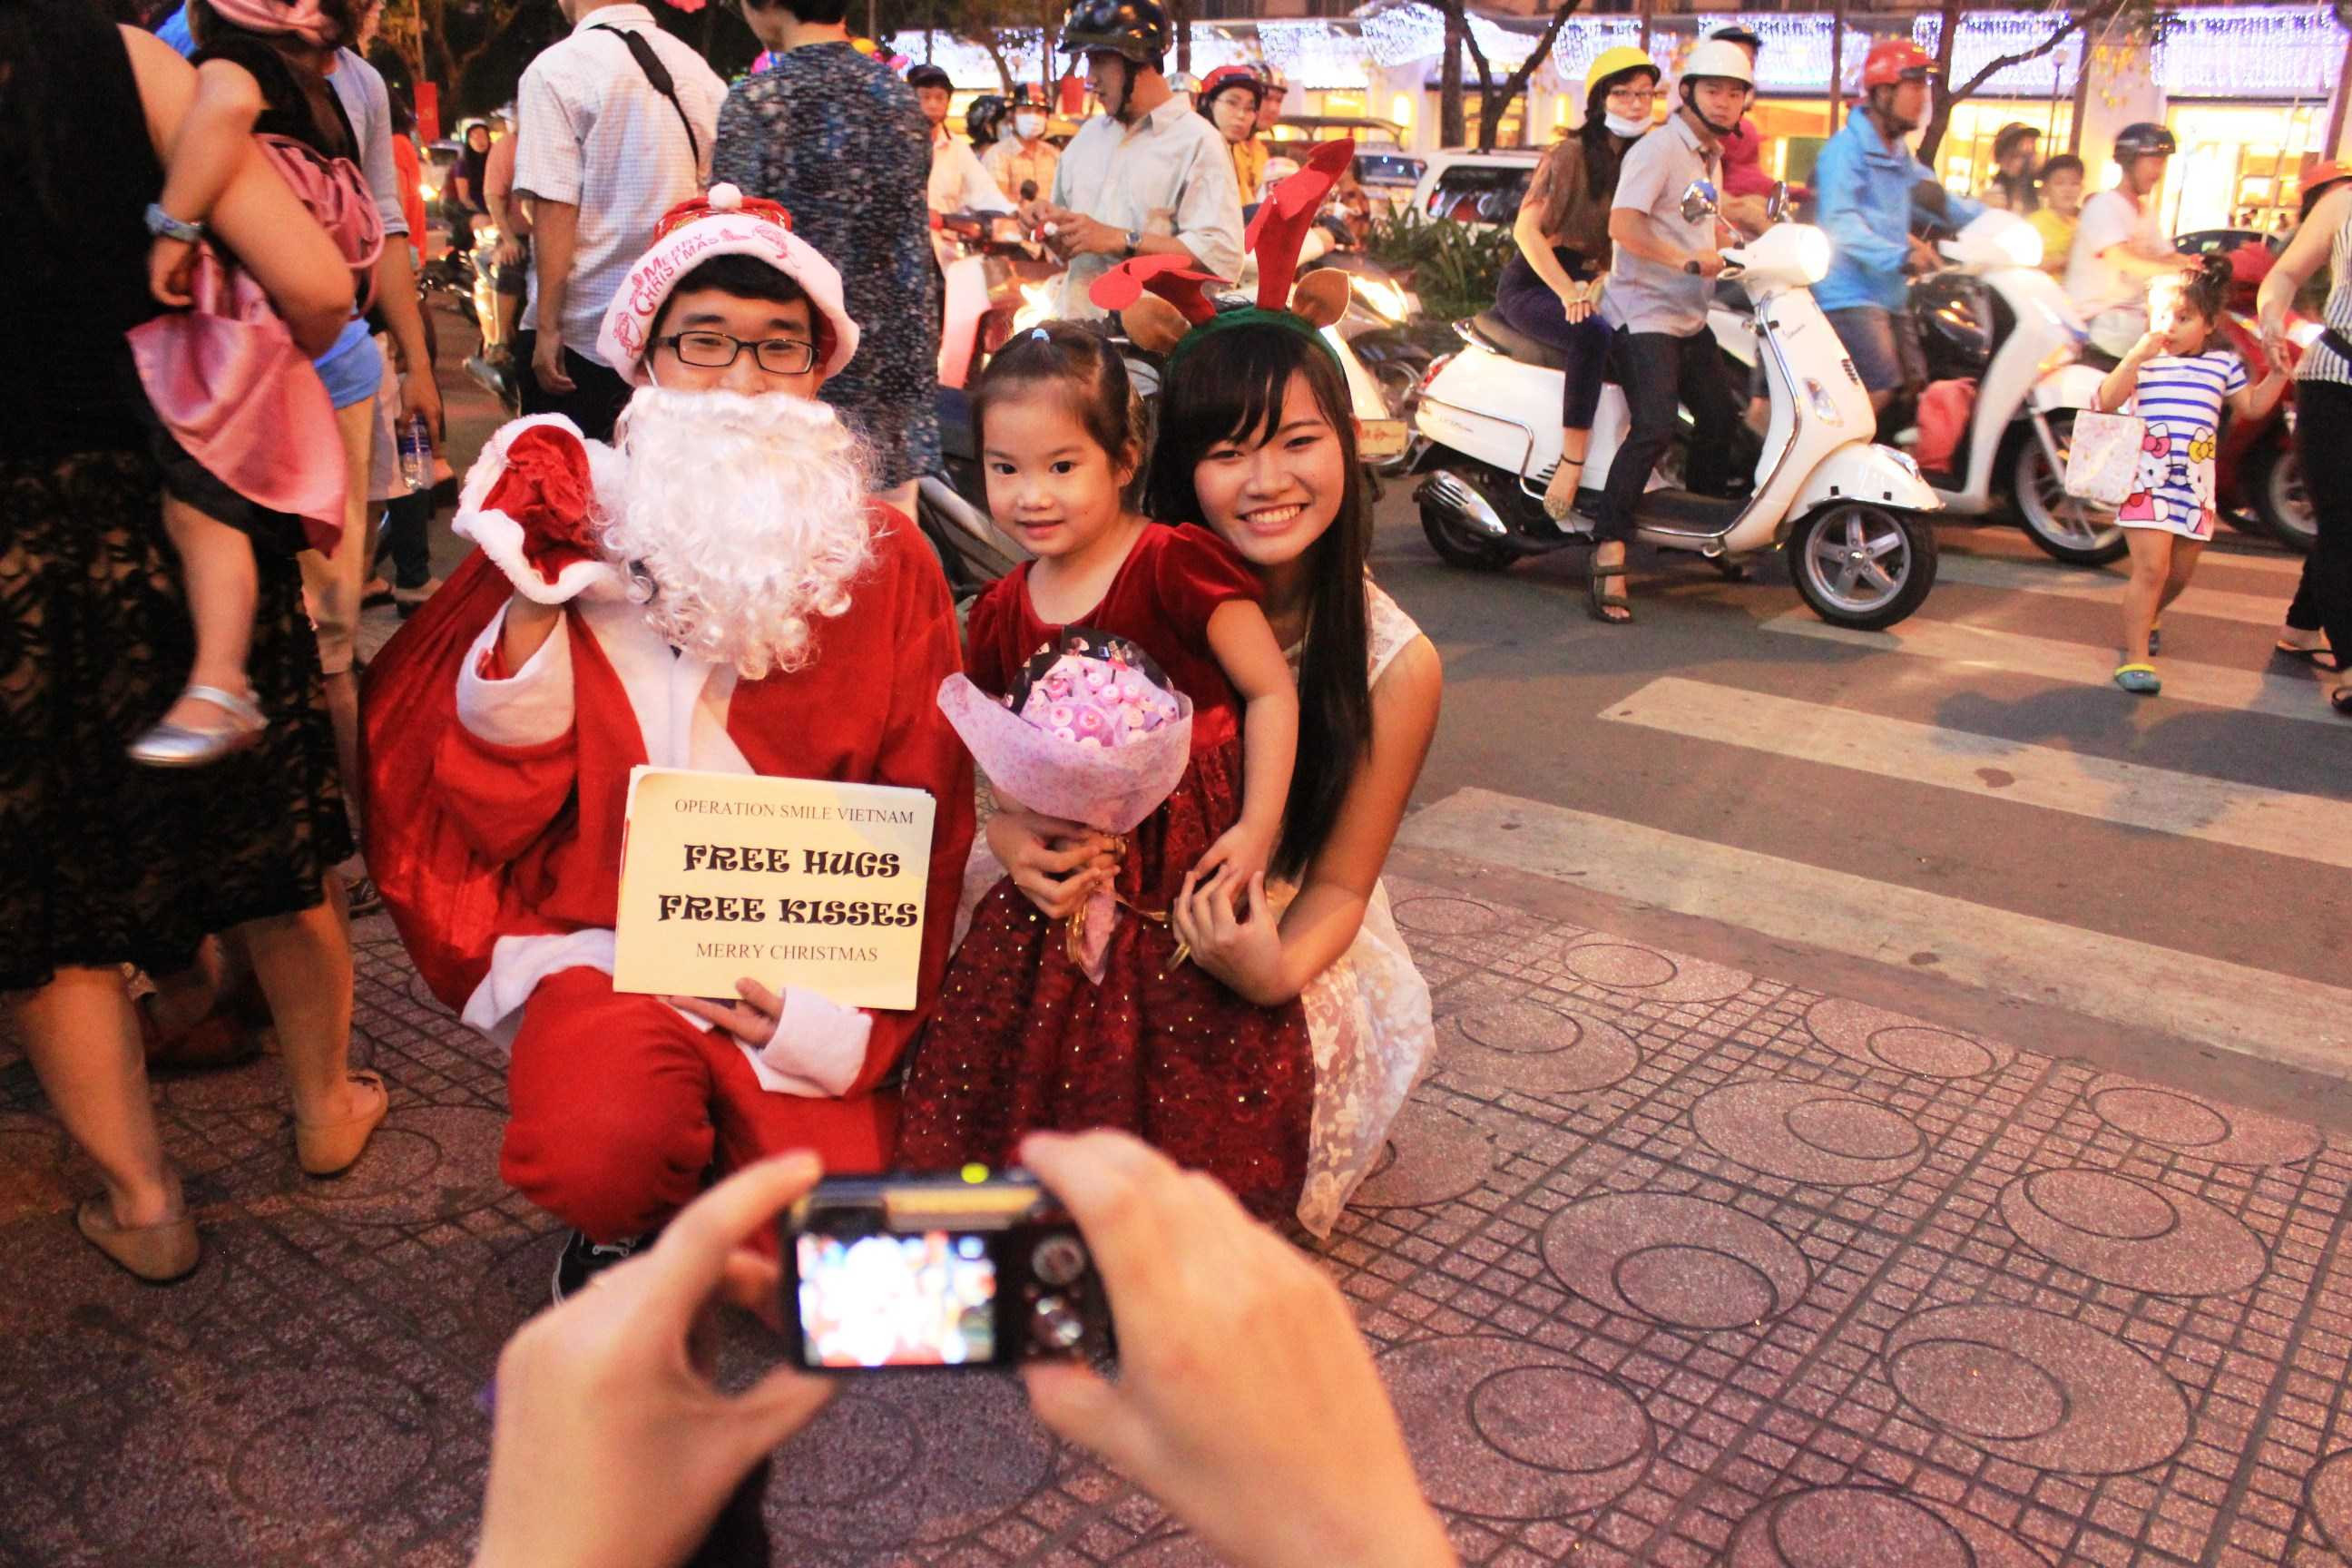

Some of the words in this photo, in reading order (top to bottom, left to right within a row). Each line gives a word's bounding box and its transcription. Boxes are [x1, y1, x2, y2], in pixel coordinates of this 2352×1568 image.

[674, 799, 774, 818] OPERATION
[779, 804, 832, 820] SMILE
[838, 807, 914, 825] VIETNAM
[682, 844, 790, 873] FREE
[803, 848, 900, 877] HUGS
[657, 894, 766, 923] FREE
[778, 897, 918, 927] KISSES
[695, 942, 764, 959] MERRY
[769, 945, 878, 963] CHRISTMAS
